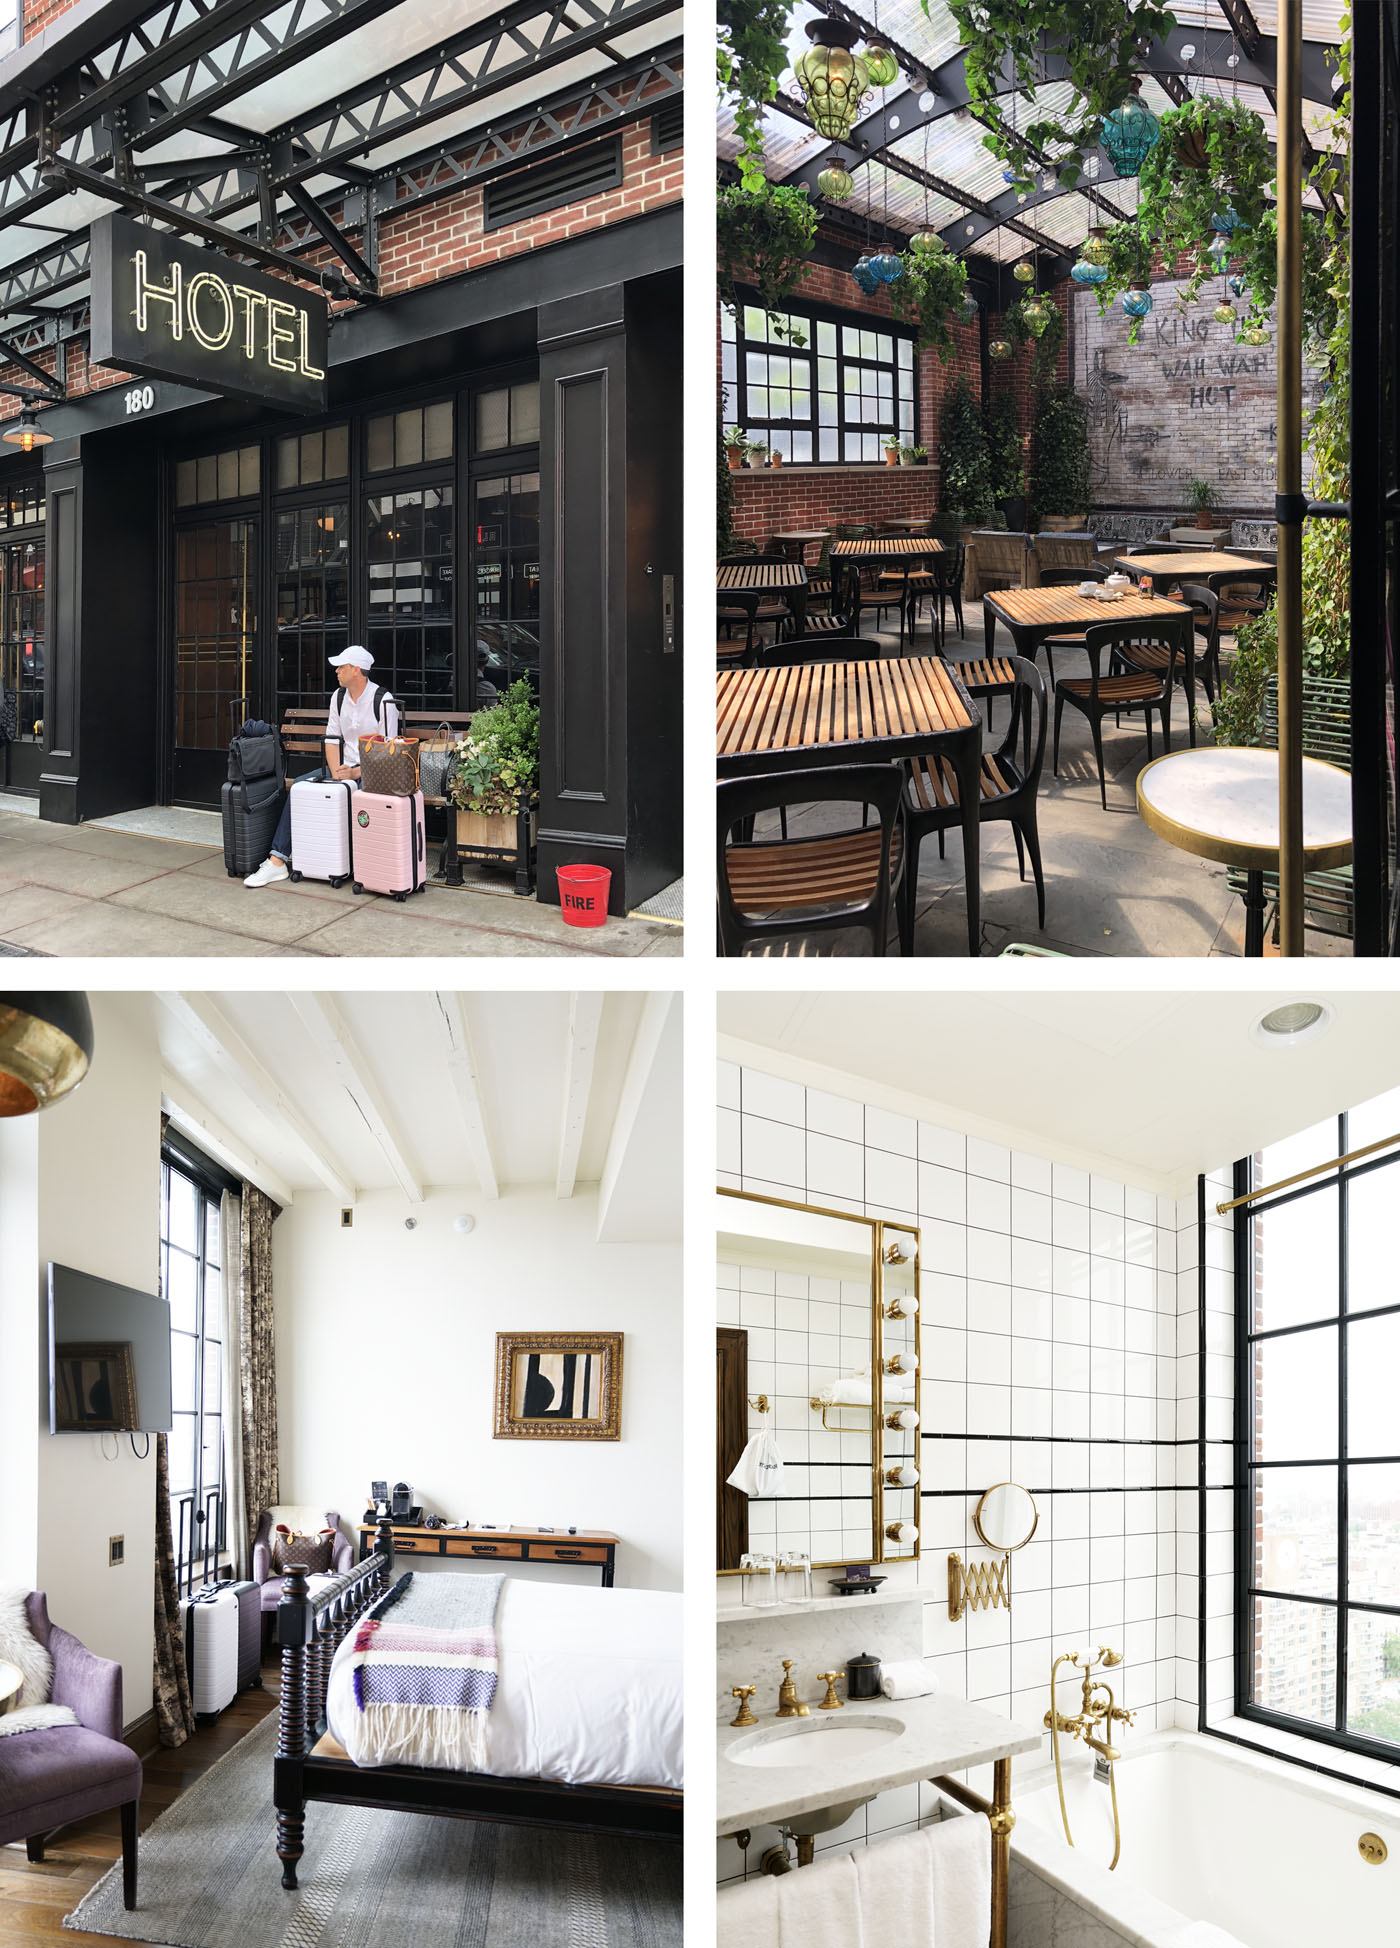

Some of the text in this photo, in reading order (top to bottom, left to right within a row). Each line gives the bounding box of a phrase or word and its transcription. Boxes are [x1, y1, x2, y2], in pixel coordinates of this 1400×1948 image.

[135, 249, 325, 380] HOTEL
[1155, 316, 1209, 348] KING
[1162, 353, 1267, 379] WAH WAH
[124, 385, 155, 415] 180
[1151, 467, 1193, 480] LOWER
[1218, 467, 1247, 480] EAST
[564, 894, 595, 910] FIRE
